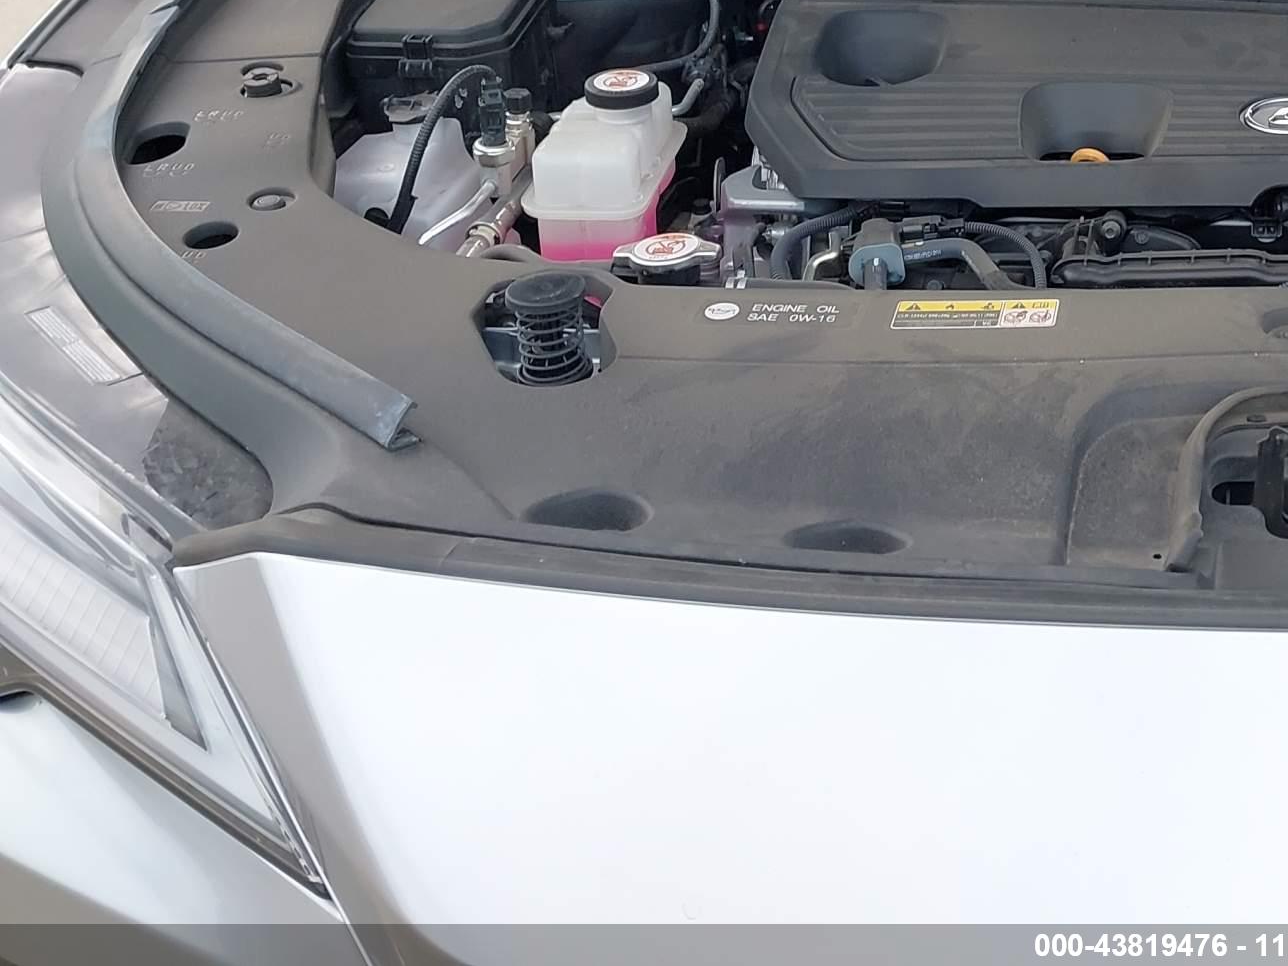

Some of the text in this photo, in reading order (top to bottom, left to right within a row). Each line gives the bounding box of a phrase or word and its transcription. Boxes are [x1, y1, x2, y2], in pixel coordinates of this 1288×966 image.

[752, 303, 840, 314] ENGINE OIL
[747, 313, 836, 323] SAE 0W-16
